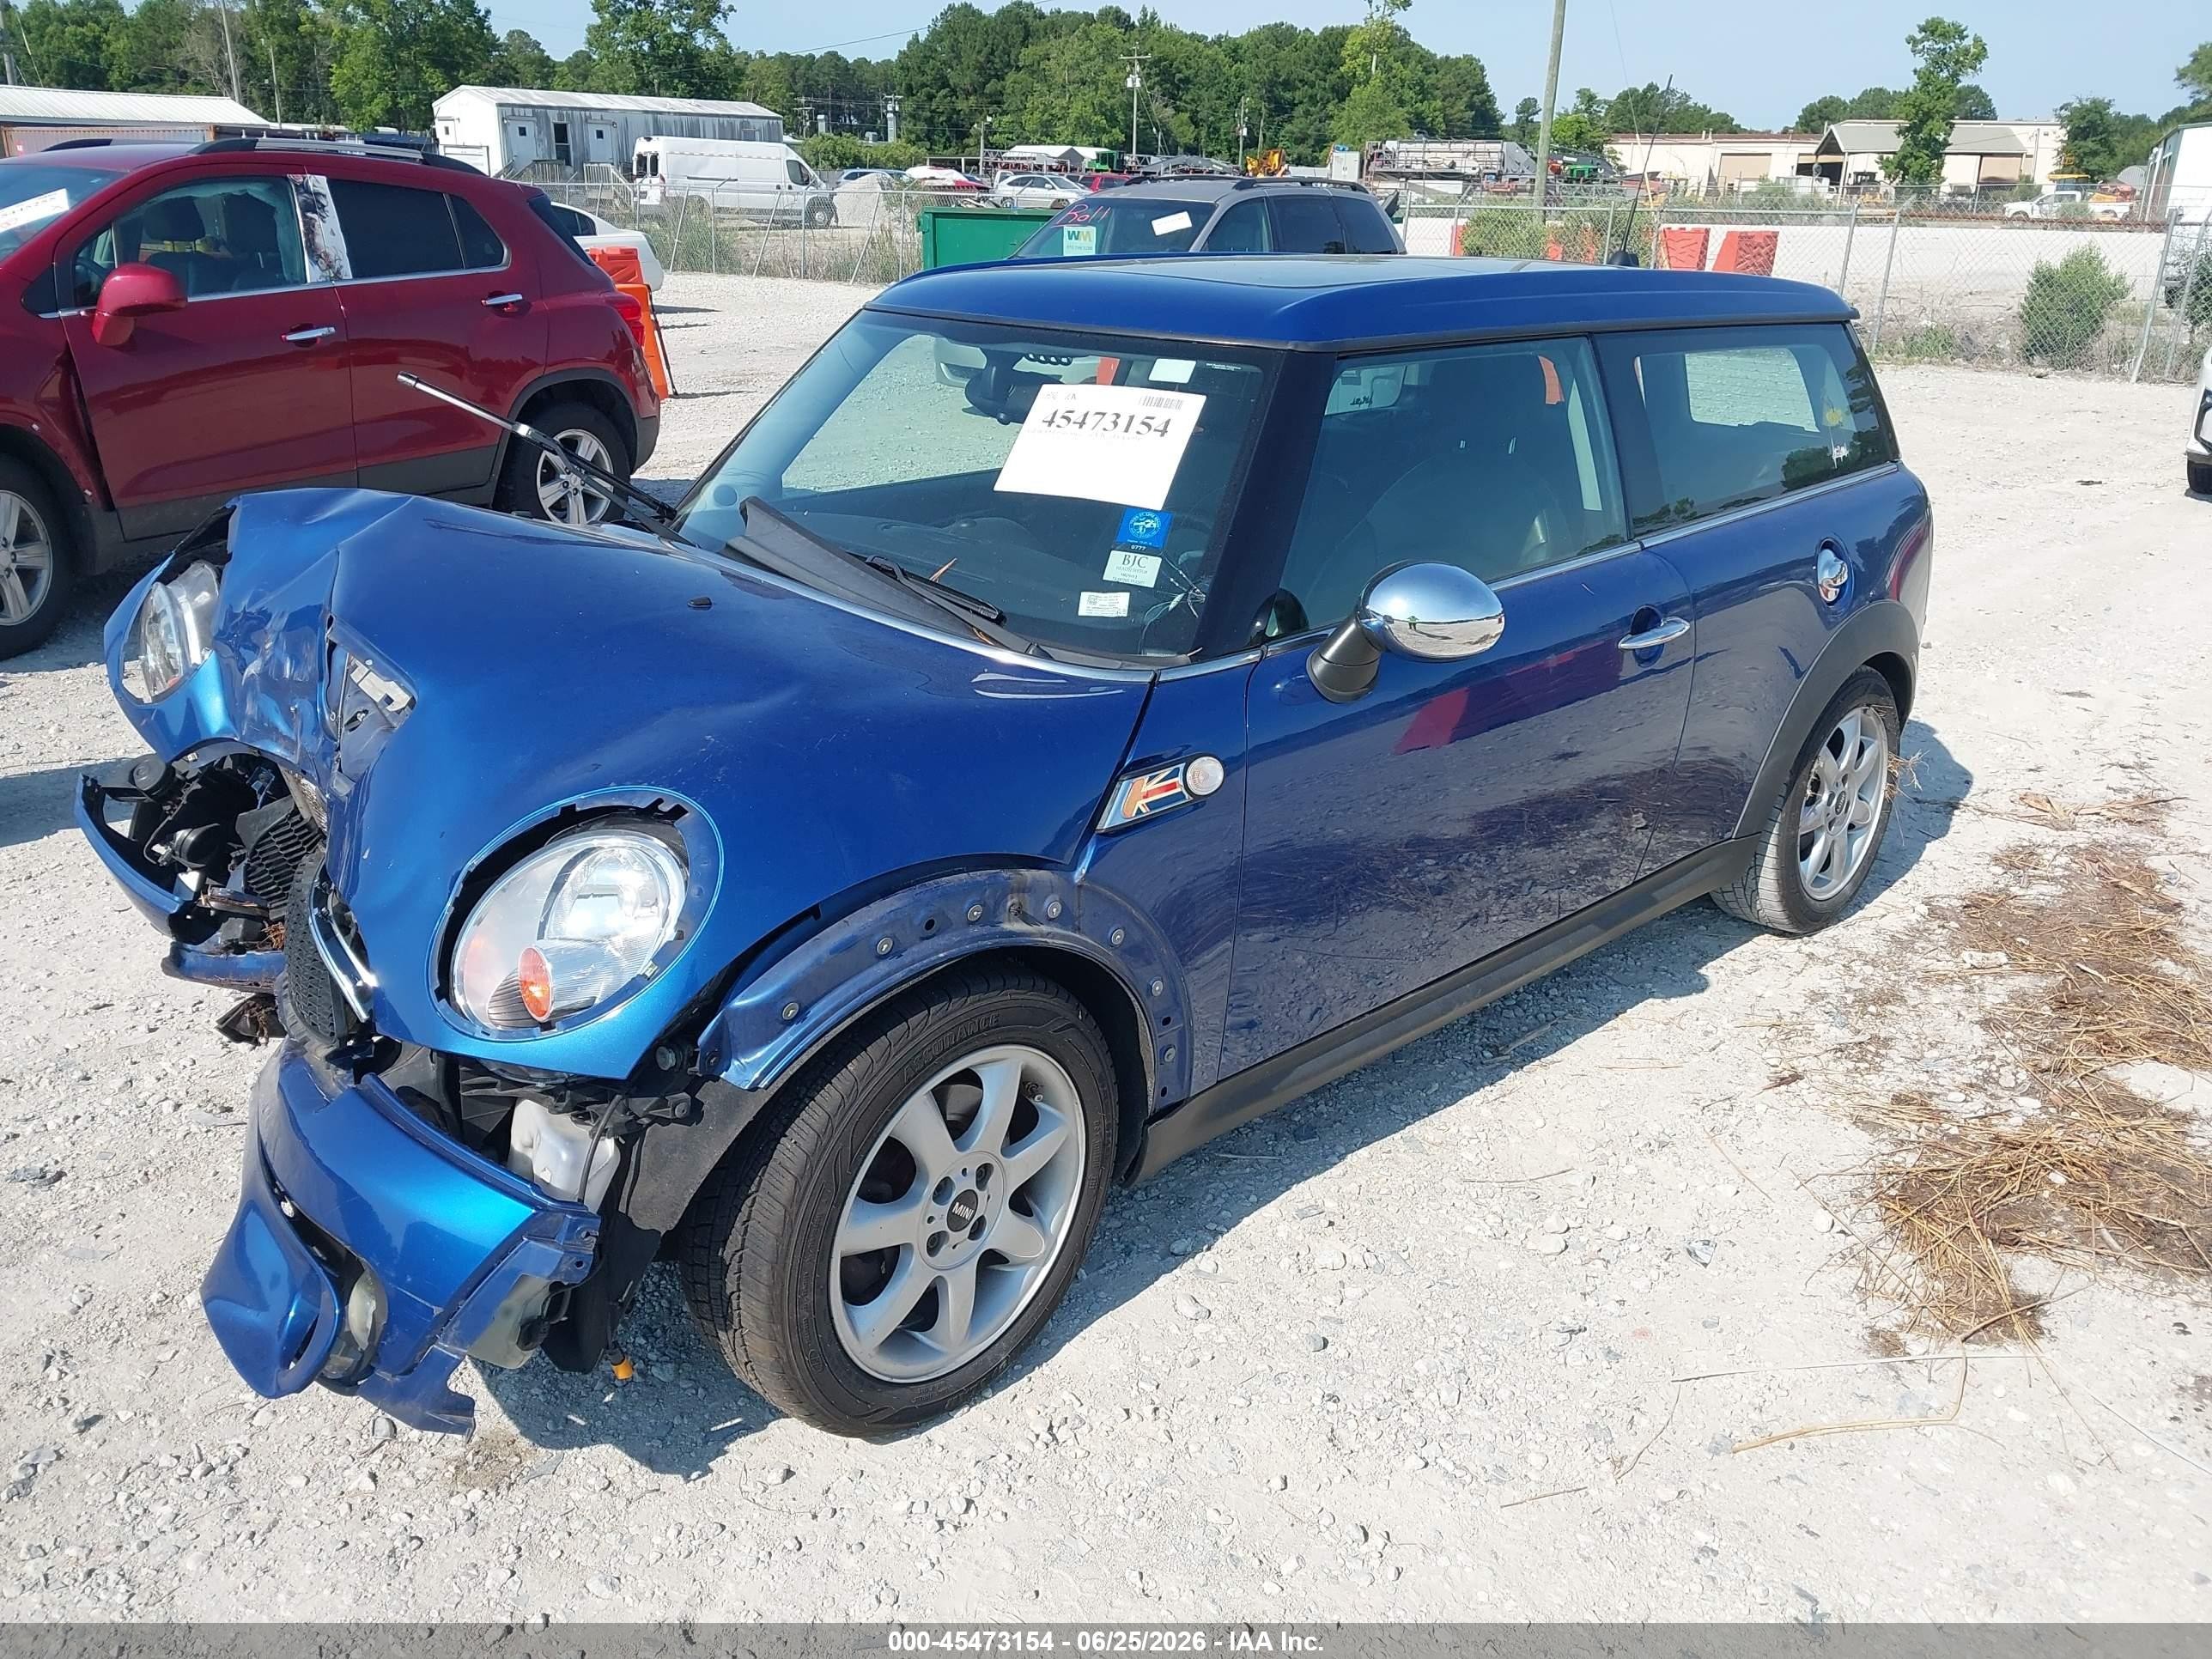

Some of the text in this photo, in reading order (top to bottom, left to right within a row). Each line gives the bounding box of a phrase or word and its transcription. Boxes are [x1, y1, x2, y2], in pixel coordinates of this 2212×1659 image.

[1067, 230, 1092, 242] WM
[1042, 409, 1171, 438] 45473154
[1122, 554, 1148, 568] BJC
[952, 1202, 975, 1221] MINI
